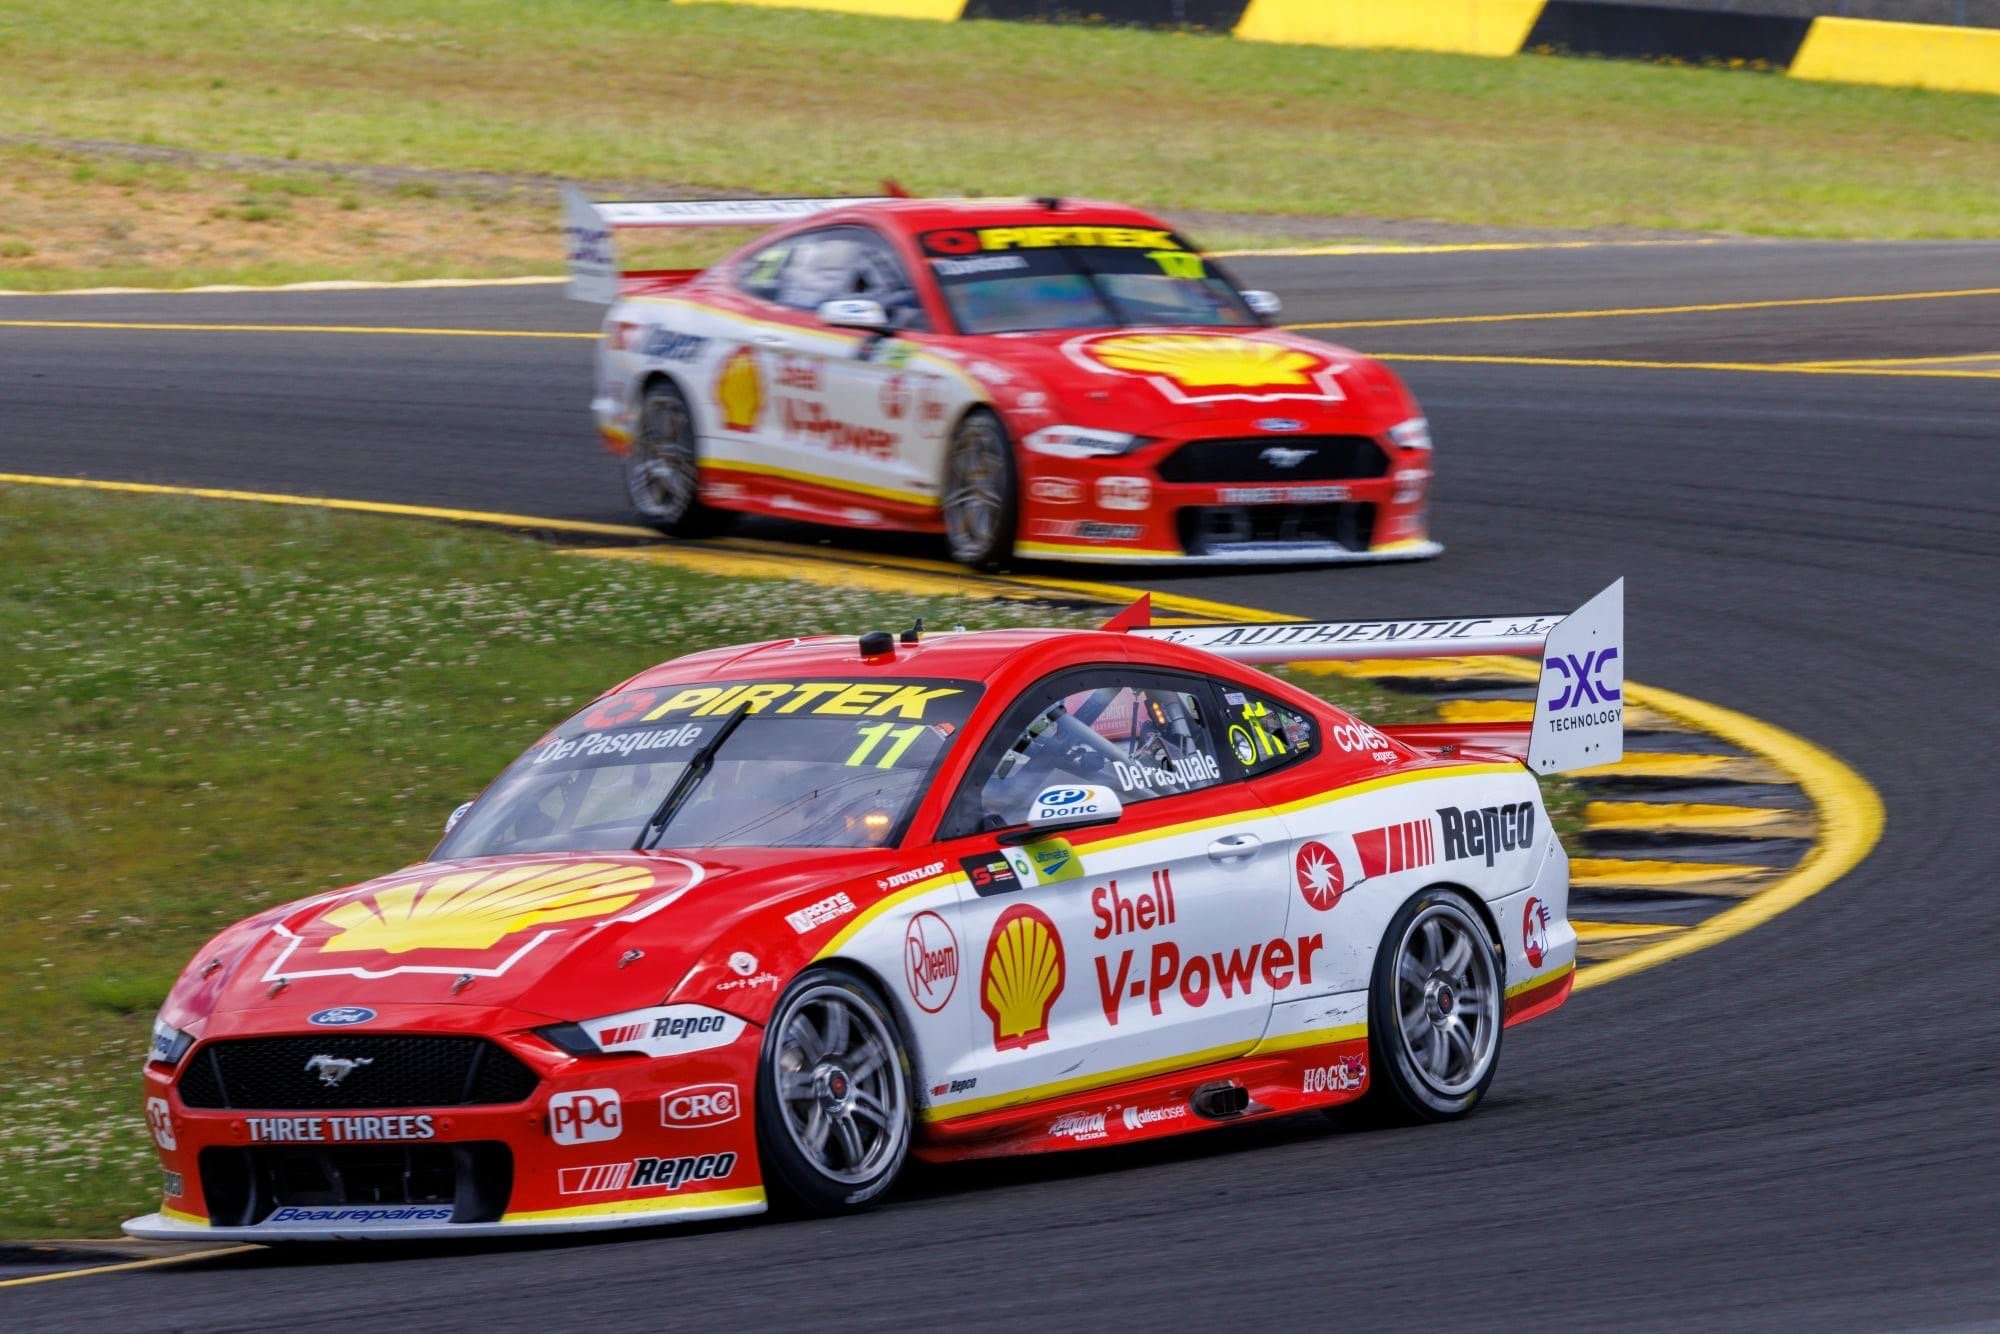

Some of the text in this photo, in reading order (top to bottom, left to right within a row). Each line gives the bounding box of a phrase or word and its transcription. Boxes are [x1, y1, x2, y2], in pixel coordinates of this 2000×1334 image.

[1203, 620, 1492, 646] AUTHENTIC
[1545, 648, 1621, 711] DXC
[639, 682, 964, 722] PIRTEK
[1549, 709, 1622, 732] TECHNOLOGY
[845, 722, 929, 769] 11
[1333, 717, 1389, 752] coles
[1436, 801, 1535, 868] Repco
[886, 862, 945, 888] DUNLOP
[1091, 868, 1176, 940] Shell
[907, 936, 957, 997] Rheem
[1093, 933, 1324, 1026] V-Power
[318, 1008, 366, 1024] Ford
[651, 1015, 726, 1039] Repco
[555, 1095, 619, 1139] PPG
[668, 1091, 733, 1120] CRC
[245, 1114, 435, 1141] THREE THREES
[628, 1152, 737, 1191] Repco
[271, 1206, 455, 1224] Beaurepaires
